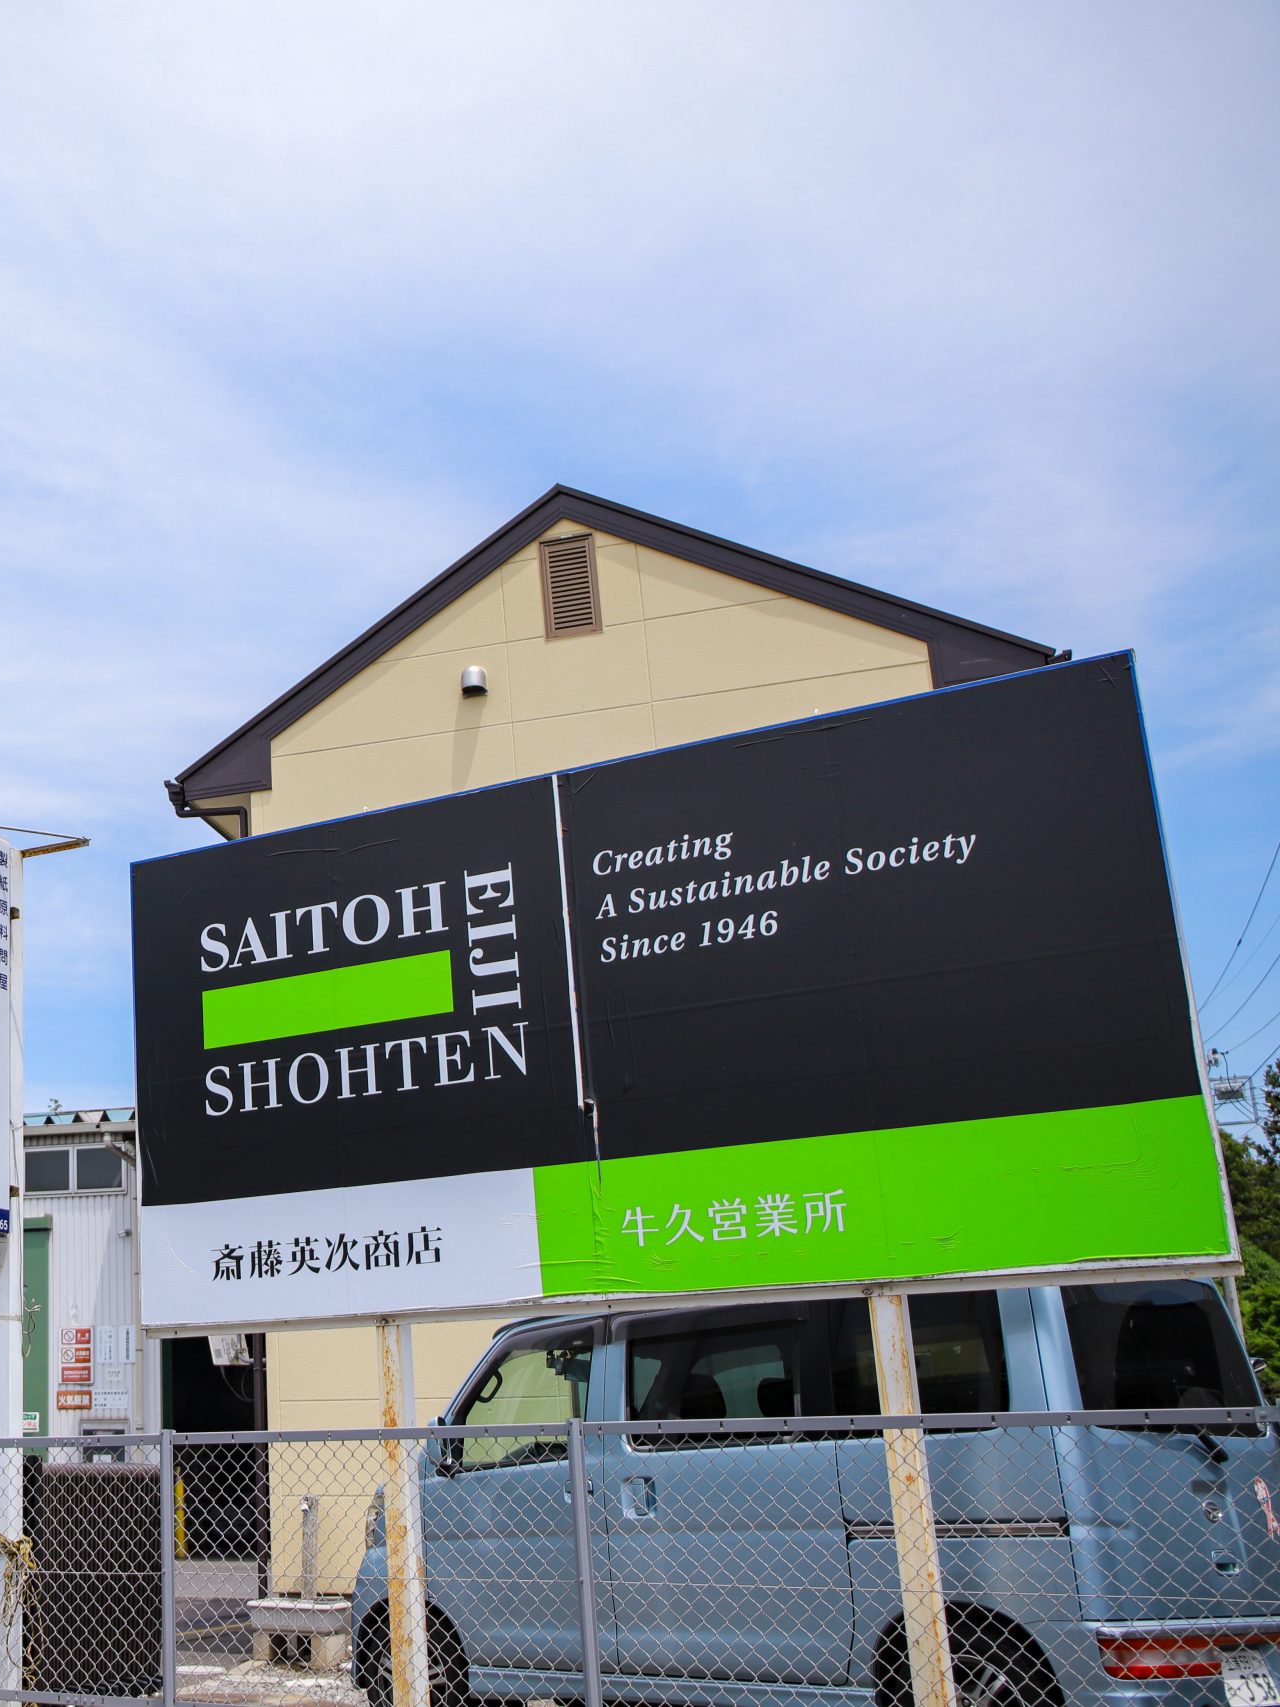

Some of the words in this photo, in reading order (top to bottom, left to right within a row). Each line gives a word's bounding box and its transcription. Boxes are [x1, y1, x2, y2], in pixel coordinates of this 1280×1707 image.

[592, 831, 734, 876] Creating
[595, 893, 618, 920] A
[628, 855, 830, 914] Sustainable
[844, 833, 977, 875] Society
[200, 881, 449, 973] SAITOH
[463, 862, 521, 1016] EIJI
[600, 931, 685, 963] Since
[698, 910, 779, 947] 1946
[204, 1022, 529, 1117] SHOHTEN
[211, 1225, 443, 1282] 斎藤英次商店
[621, 1188, 848, 1248] 牛久営業所
